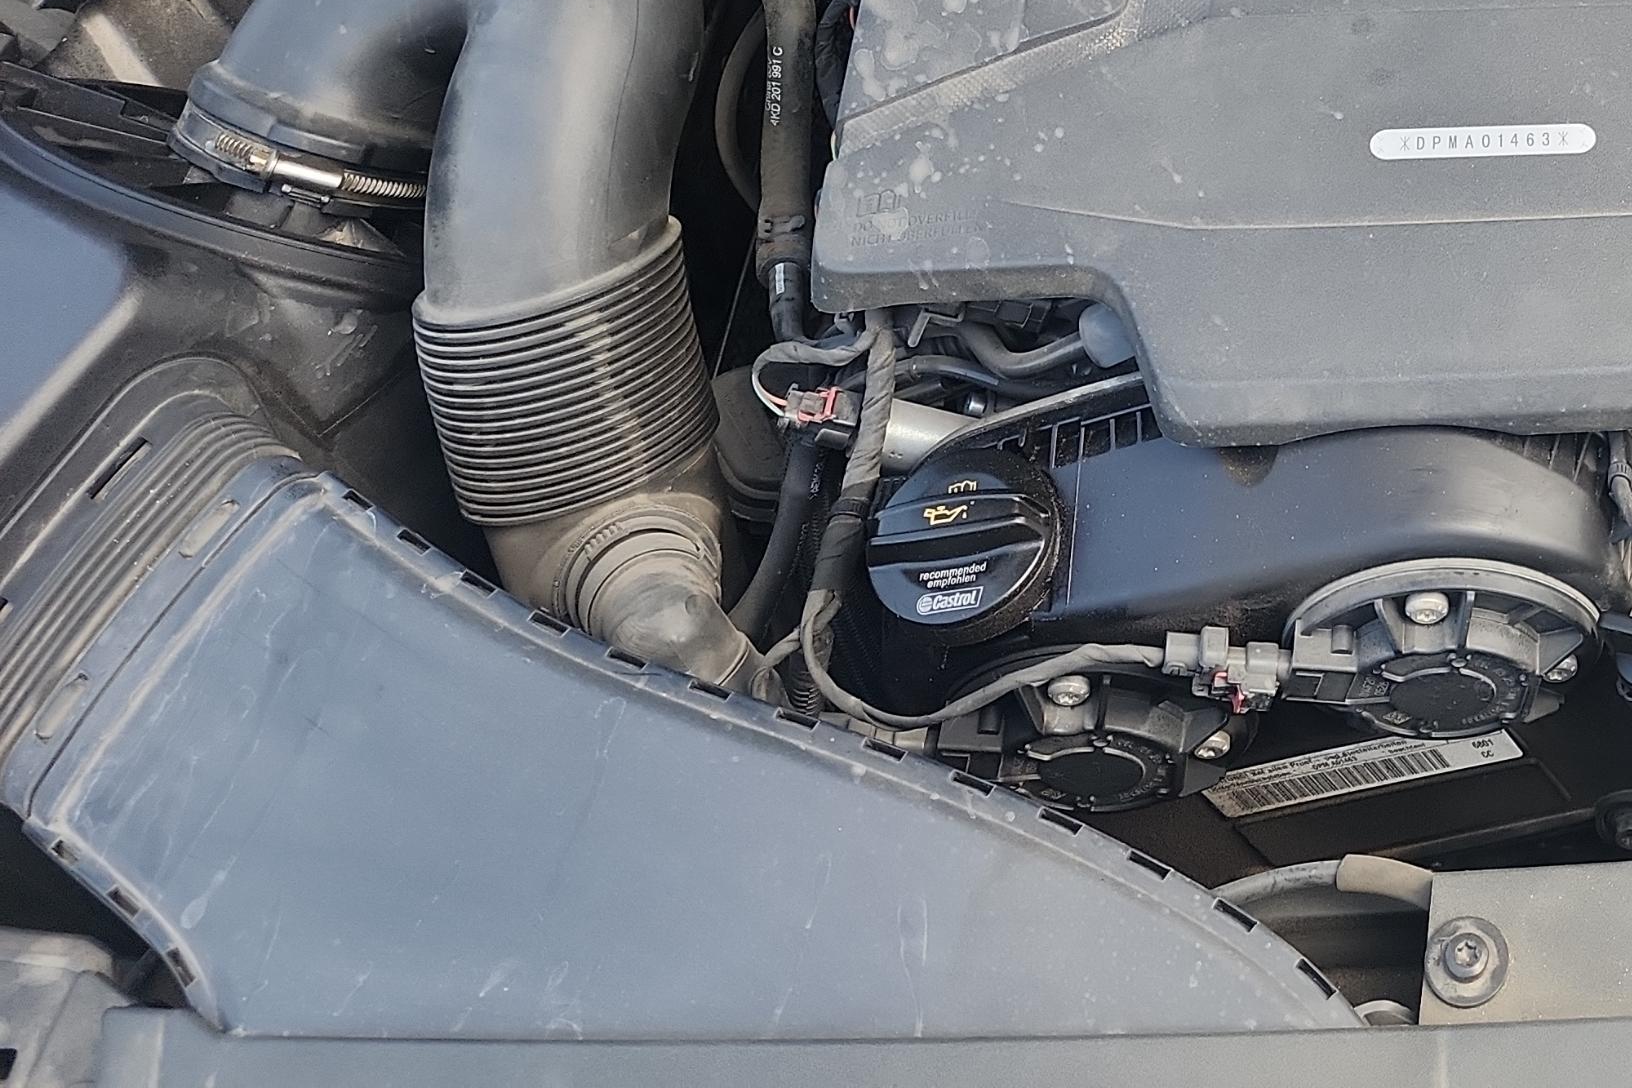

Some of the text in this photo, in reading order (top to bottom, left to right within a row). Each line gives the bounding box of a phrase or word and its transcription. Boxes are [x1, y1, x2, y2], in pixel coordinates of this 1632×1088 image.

[772, 46, 783, 57] C
[772, 59, 782, 79] 991
[772, 81, 781, 102] 201
[919, 562, 987, 581] recommended
[926, 573, 977, 589] empfohlen
[932, 589, 978, 611] Castrol
